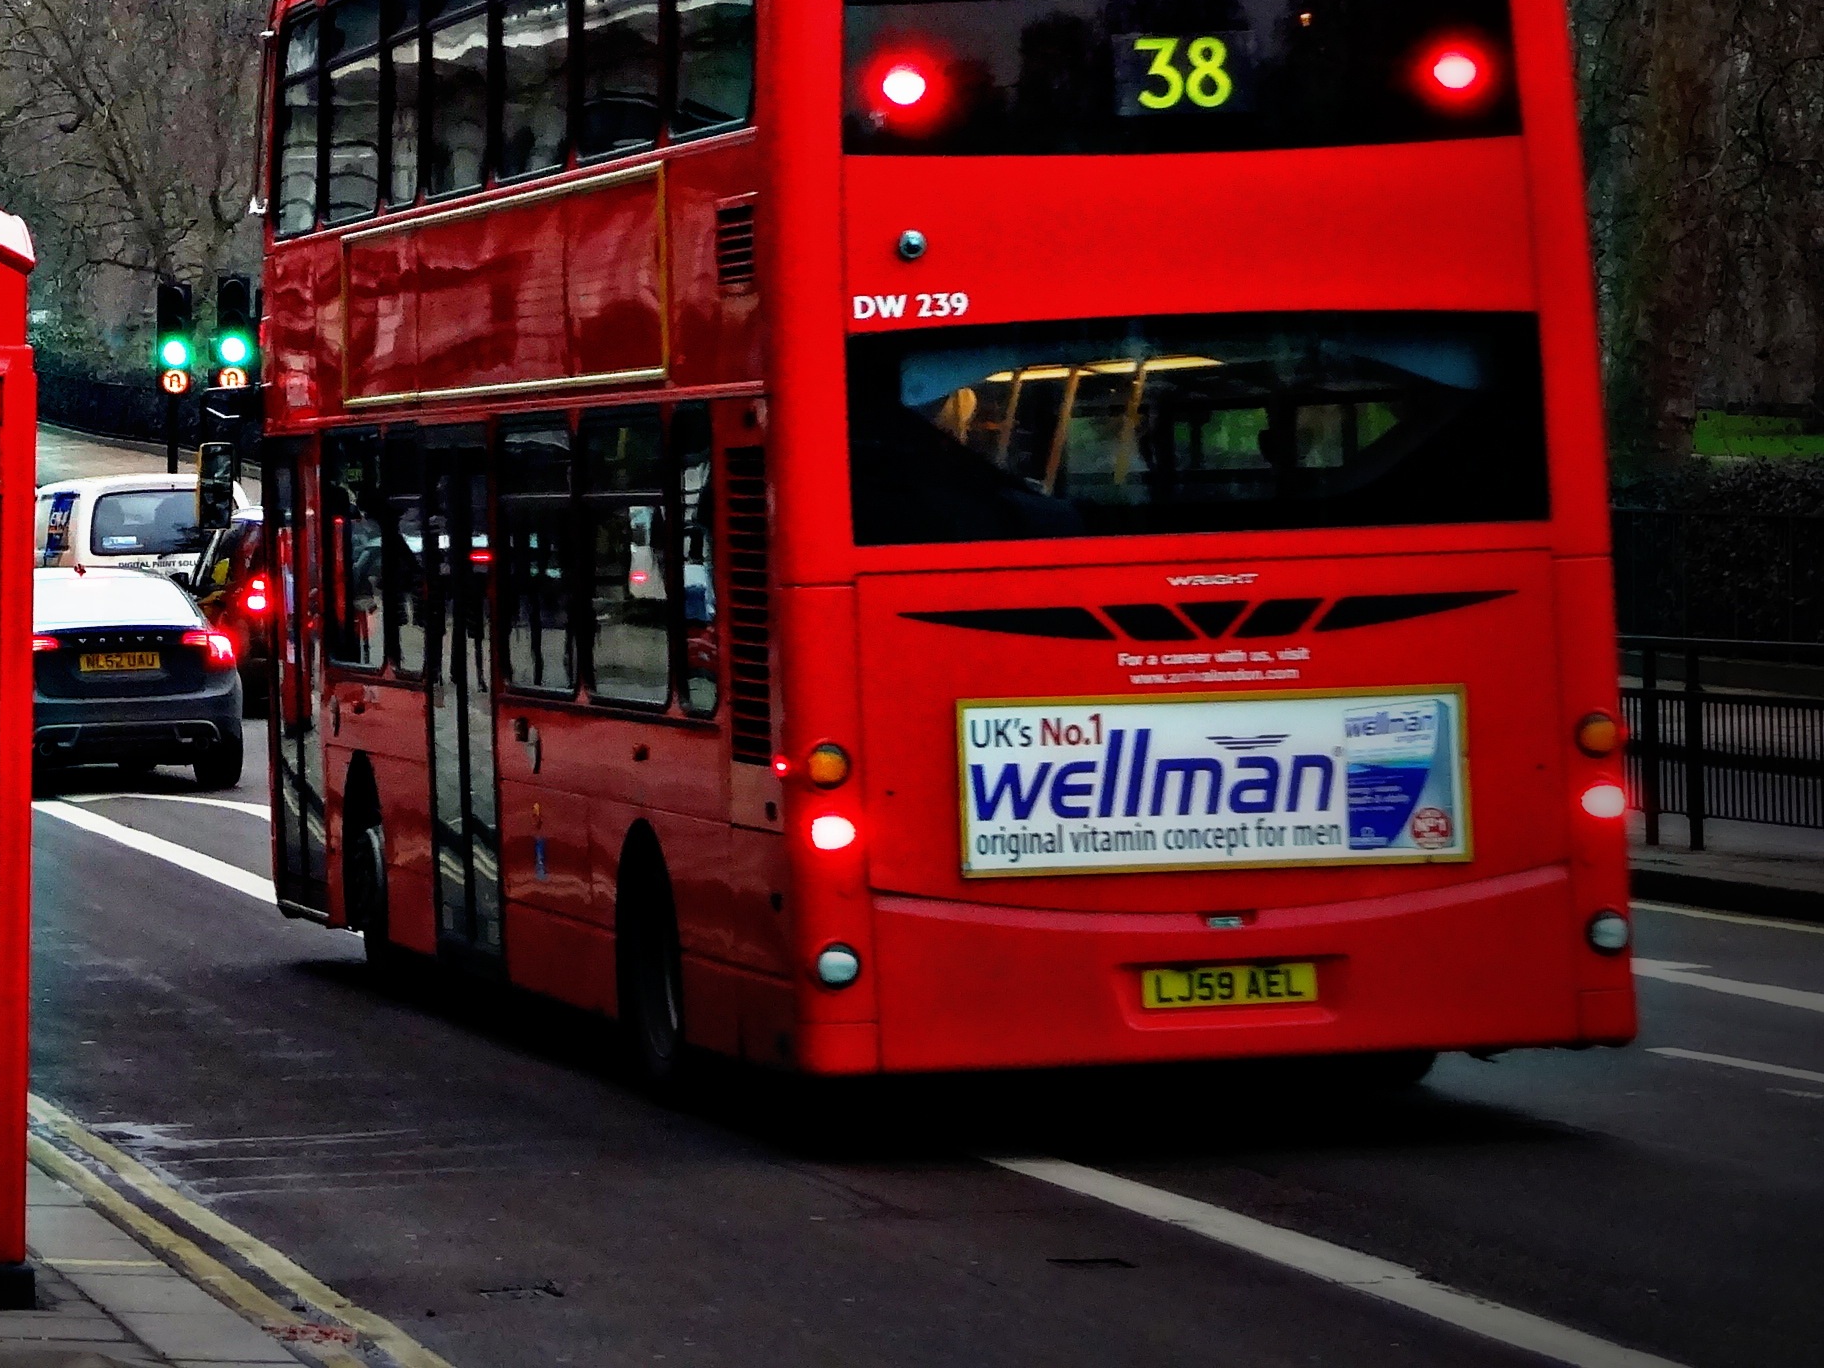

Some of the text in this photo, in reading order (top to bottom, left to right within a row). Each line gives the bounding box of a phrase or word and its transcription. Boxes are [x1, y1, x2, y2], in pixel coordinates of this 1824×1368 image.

[1133, 35, 1233, 110] 38
[852, 292, 969, 320] DW 239
[118, 561, 150, 569] DIGITAL
[153, 560, 176, 568] PRINT
[1117, 652, 1143, 666] For
[1146, 654, 1158, 665] a
[1214, 649, 1247, 662] with
[1276, 647, 1311, 661] visit
[970, 713, 1104, 749] UK's No.1
[969, 728, 1335, 822] wellman
[975, 818, 1342, 863] original vitamin concept for men
[1155, 968, 1305, 1004] LJ59 AEL
